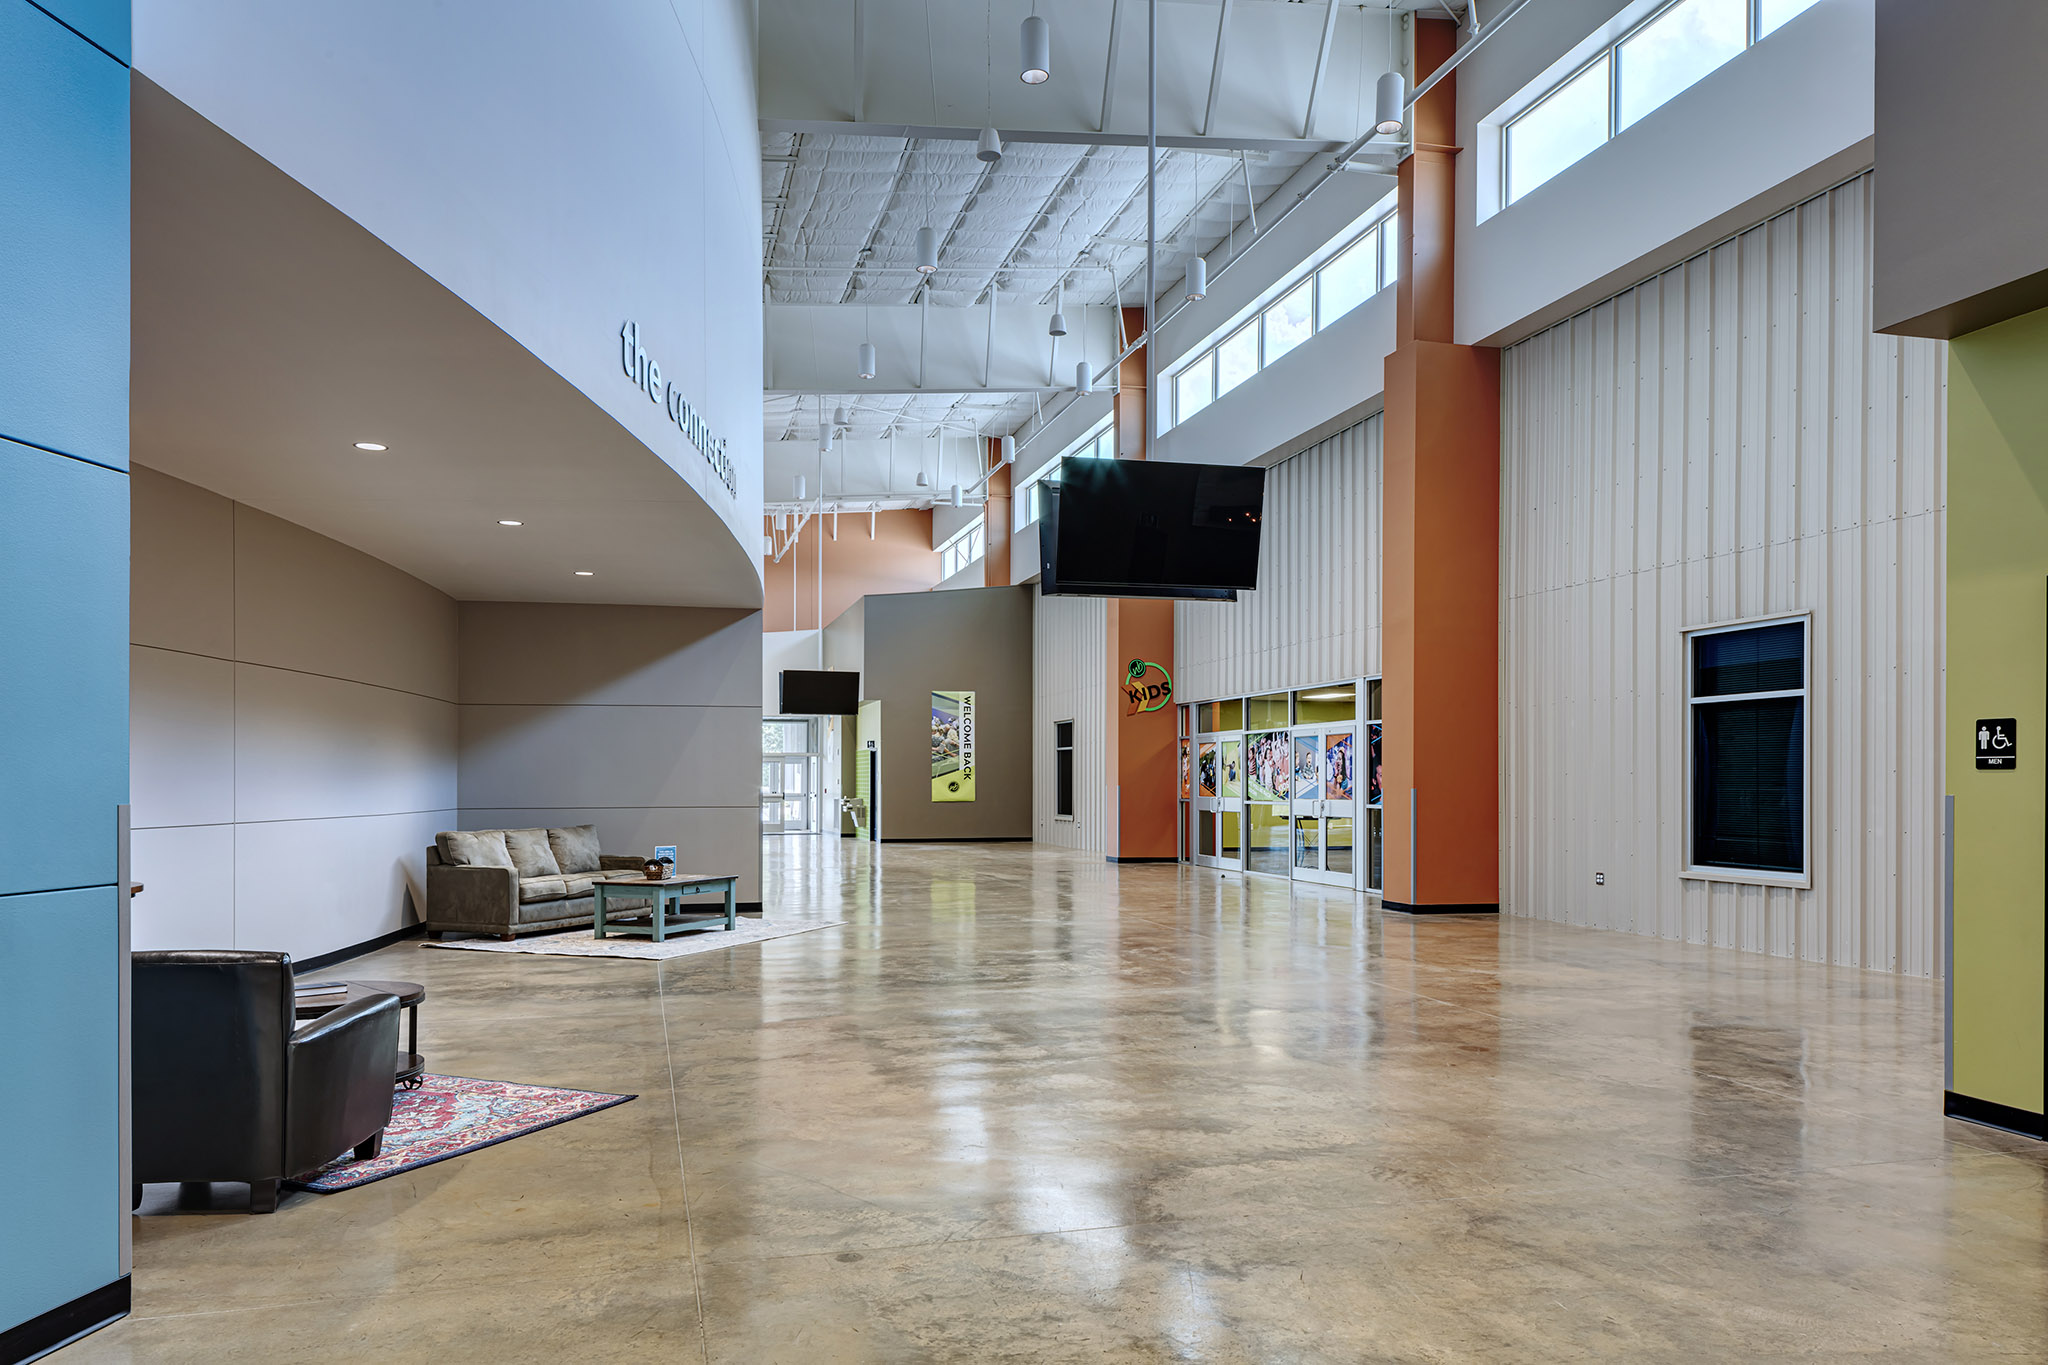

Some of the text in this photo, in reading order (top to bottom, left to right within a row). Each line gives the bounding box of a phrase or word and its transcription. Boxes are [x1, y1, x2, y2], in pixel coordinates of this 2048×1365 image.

[620, 319, 662, 404] the
[1129, 681, 1172, 704] KIDS
[963, 695, 972, 780] WELCOME BACK
